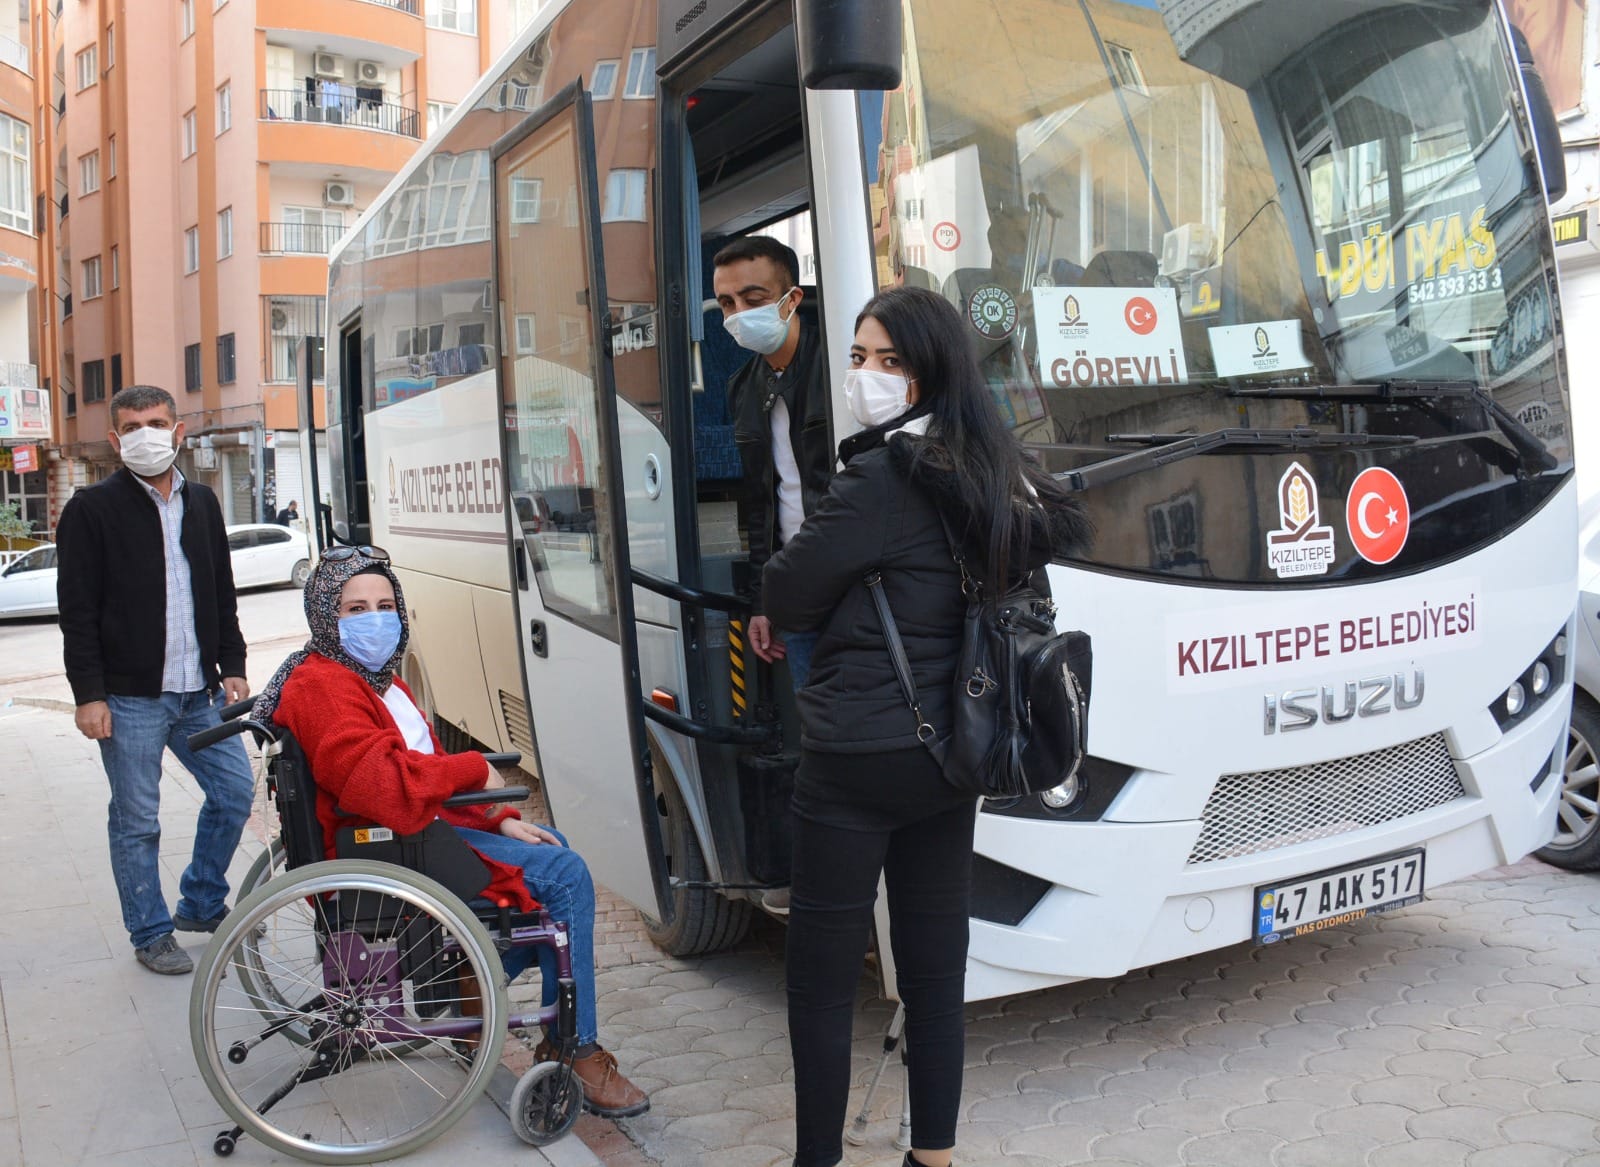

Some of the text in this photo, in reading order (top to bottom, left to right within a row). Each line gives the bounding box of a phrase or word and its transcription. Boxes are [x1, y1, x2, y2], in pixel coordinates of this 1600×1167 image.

[1409, 282, 1434, 303] 542
[1438, 276, 1465, 296] 393
[986, 305, 1000, 316] OK
[1051, 348, 1181, 388] GÖREVLİ
[401, 464, 454, 513] KIZILTEPE
[1271, 546, 1332, 565] KIZILTEPE
[1280, 561, 1326, 574] BELEDİYESİ
[1178, 593, 1475, 676] KIZILTEPE BELEDİYESİ
[1263, 670, 1425, 735] ISUZU
[1275, 860, 1417, 924] 47 AAK 517
[1260, 915, 1273, 927] TR
[1296, 922, 1315, 936] NAS
